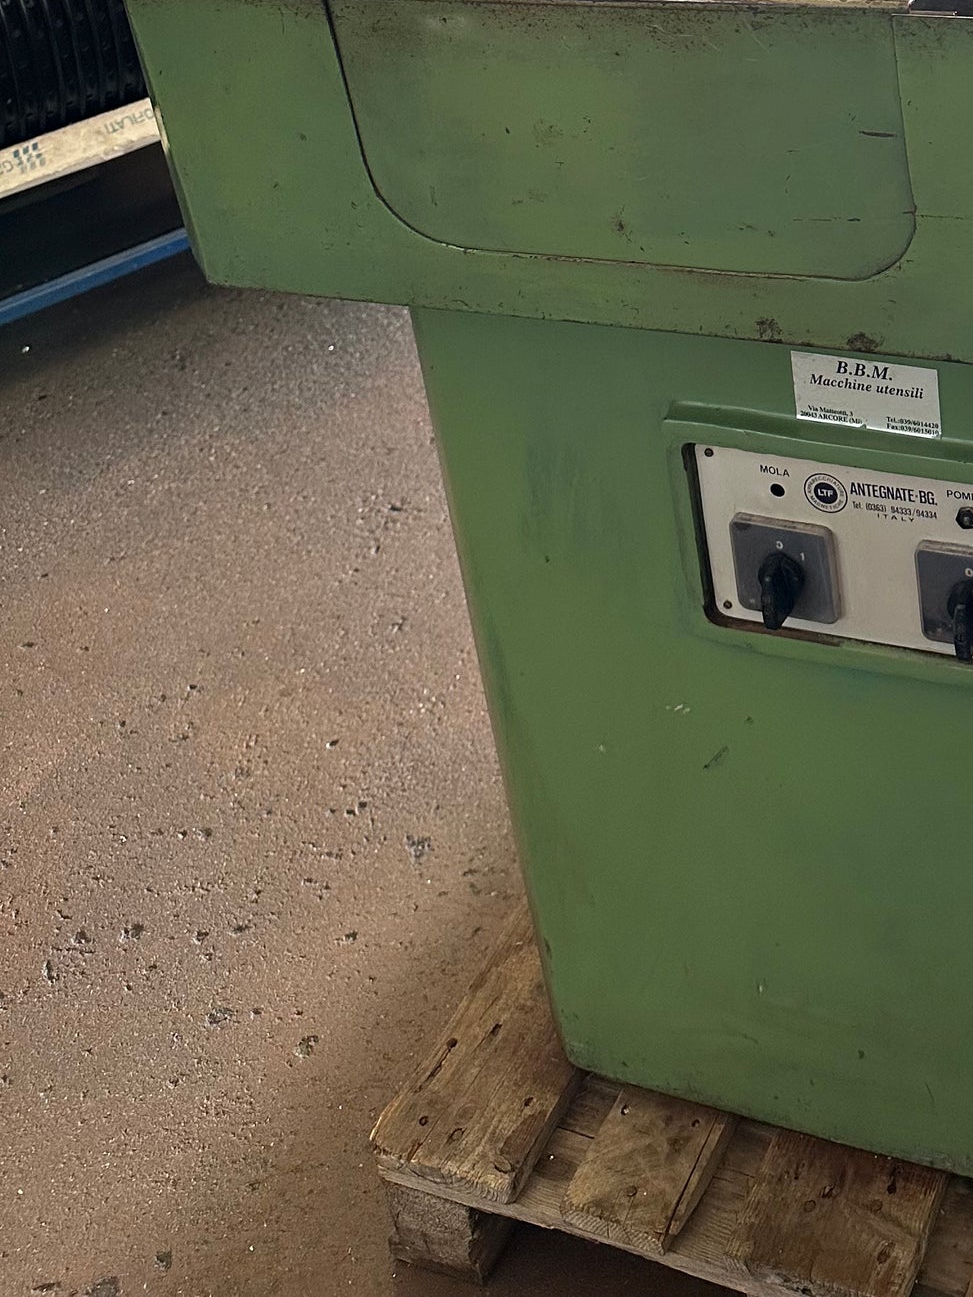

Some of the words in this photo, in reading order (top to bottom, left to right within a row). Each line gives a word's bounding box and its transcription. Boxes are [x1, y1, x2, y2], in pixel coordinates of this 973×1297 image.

[836, 360, 893, 381] B.B.M.
[809, 373, 872, 392] Macchine
[876, 385, 924, 399] utensili
[807, 404, 819, 412] Via
[818, 413, 848, 423] ARCORE
[759, 464, 790, 478] MOLA
[817, 488, 834, 498] LTF
[877, 513, 915, 523] ITALY
[799, 552, 806, 562] 1
[964, 567, 973, 578] 0
